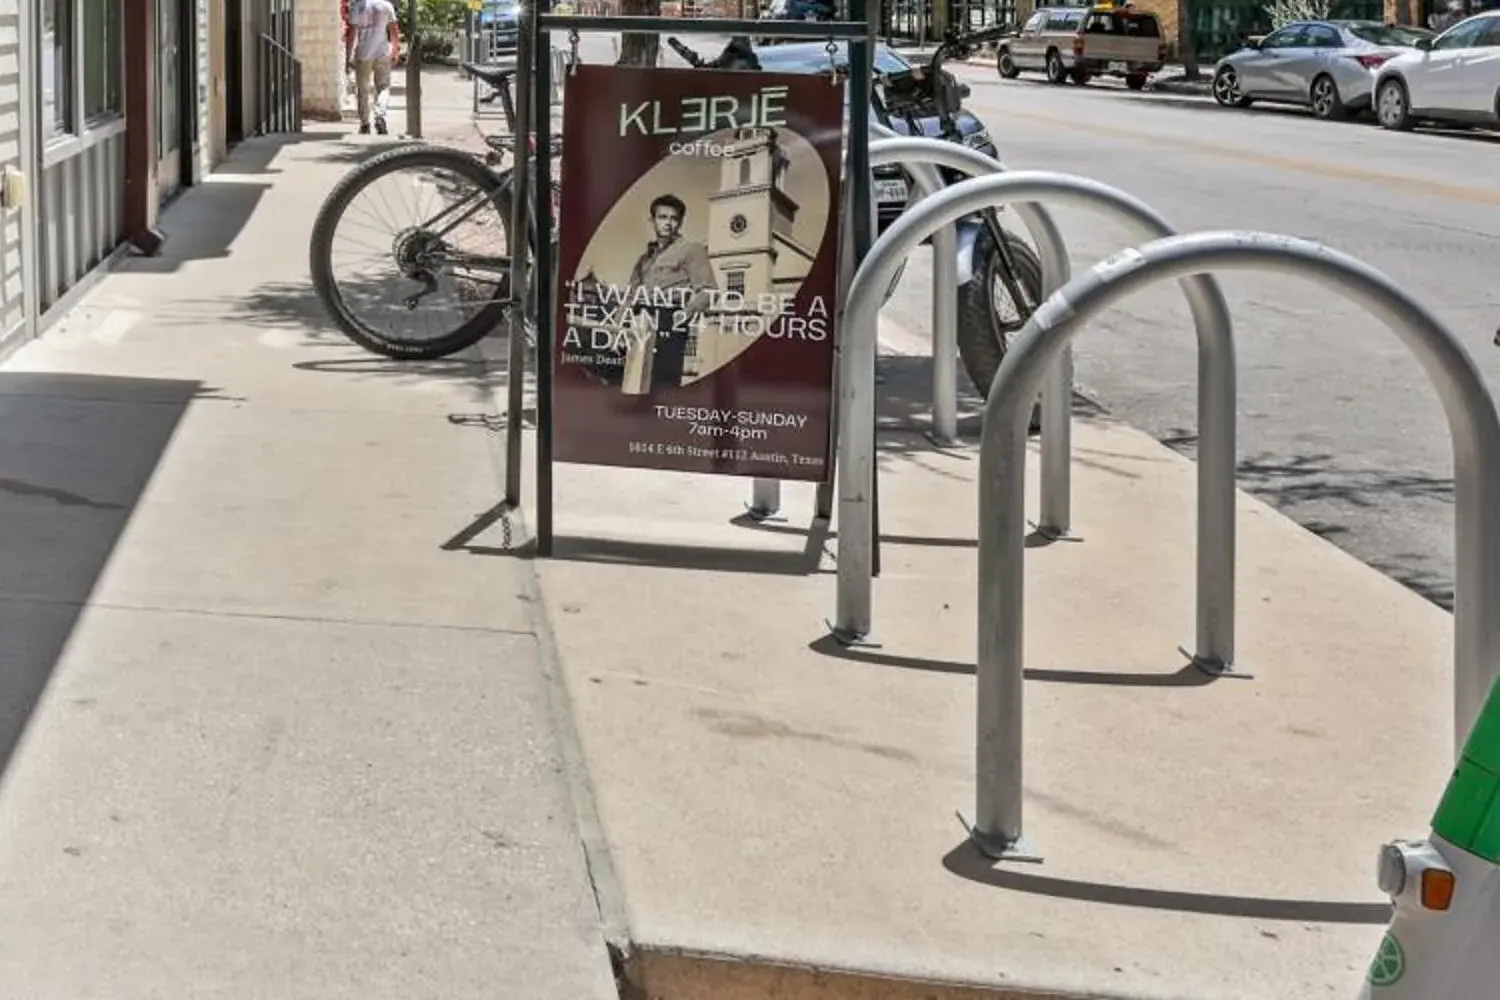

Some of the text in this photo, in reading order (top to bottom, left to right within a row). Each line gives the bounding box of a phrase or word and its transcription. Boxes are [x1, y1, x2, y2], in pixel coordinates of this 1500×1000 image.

[669, 139, 735, 158] coffee
[596, 284, 693, 308] WANT
[704, 289, 744, 312] TO
[757, 293, 796, 316] BE
[808, 296, 829, 318] A
[564, 303, 828, 341] TEXAN 24 HOURS
[562, 327, 582, 349] A
[561, 351, 594, 366] James
[654, 405, 808, 428] TUESDAY-SUNDAY
[688, 421, 768, 442] 7am-4pm
[657, 444, 665, 455] E
[666, 444, 685, 456] 6th
[687, 446, 719, 460] Street
[750, 451, 789, 466] Austin,
[792, 453, 825, 467] Texas
